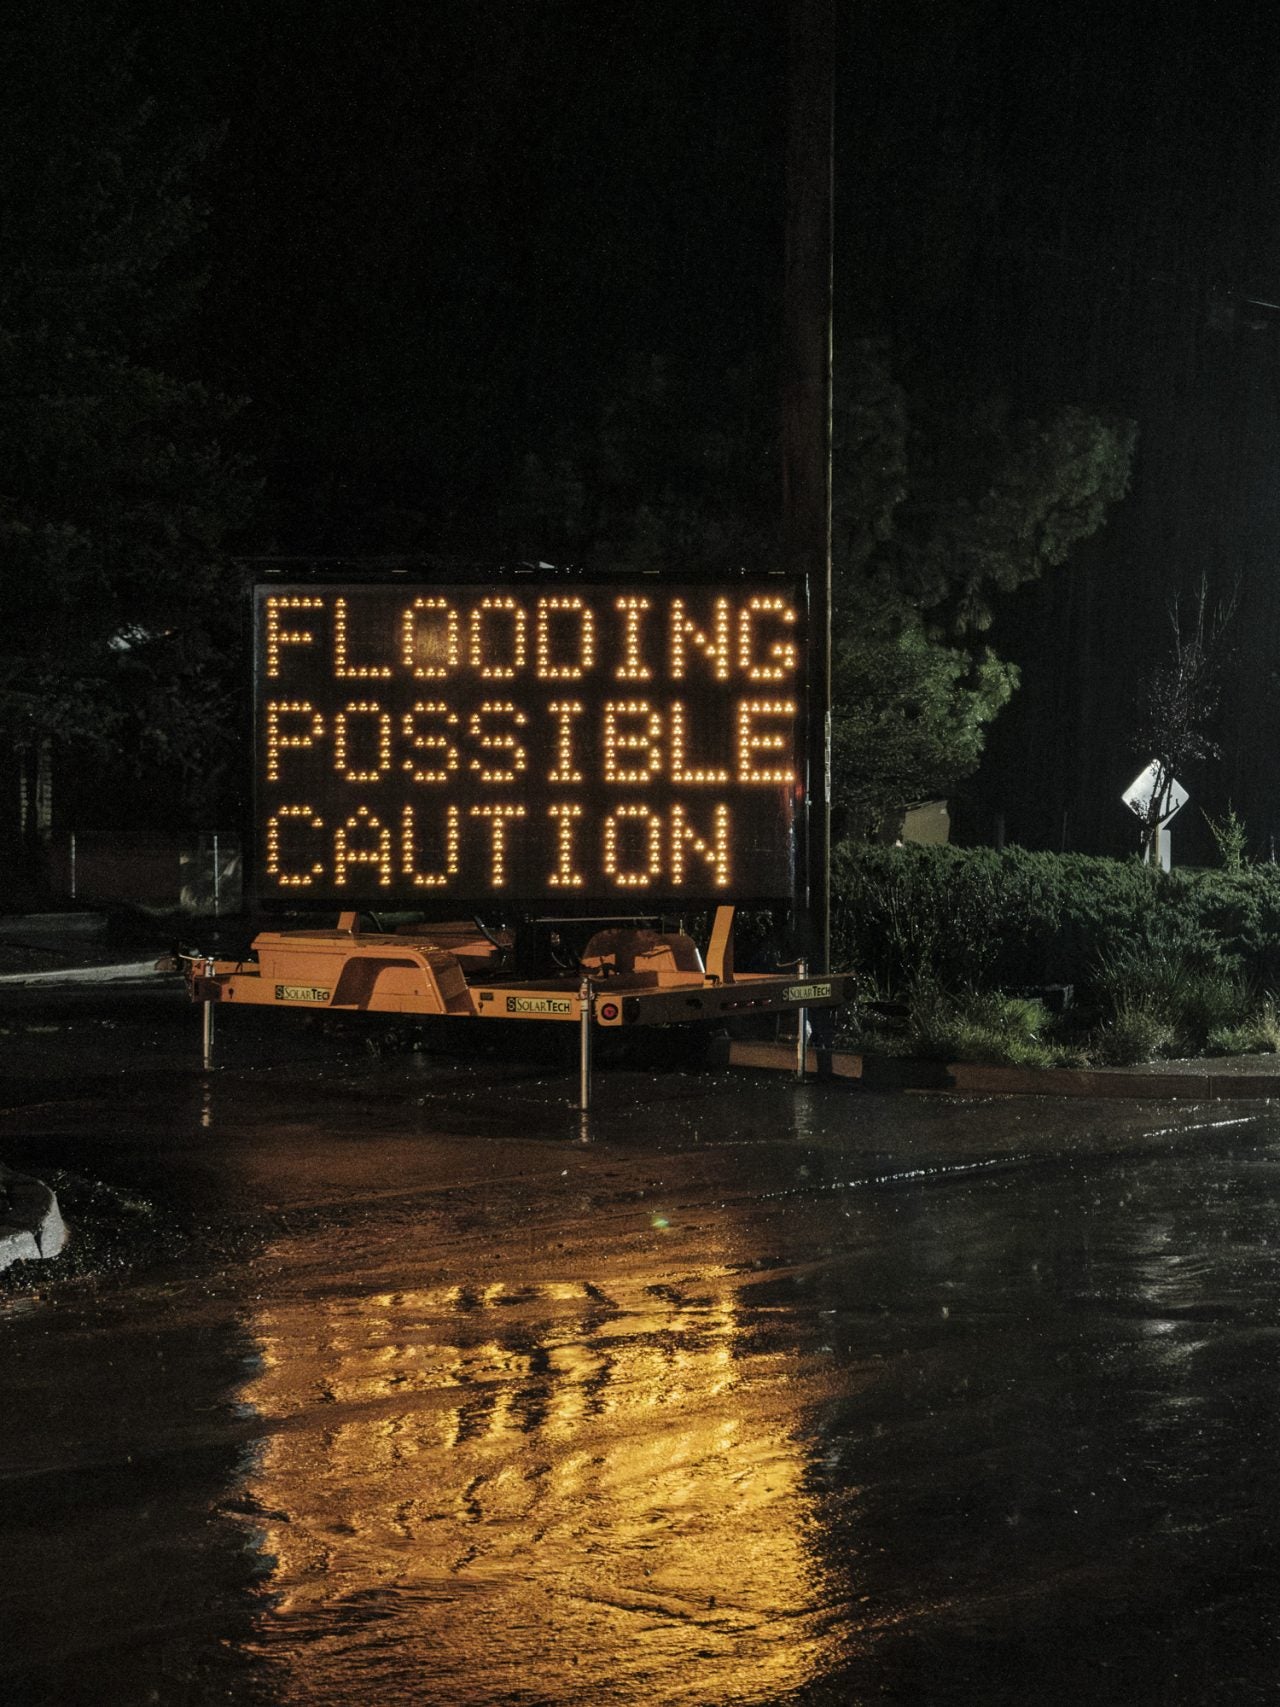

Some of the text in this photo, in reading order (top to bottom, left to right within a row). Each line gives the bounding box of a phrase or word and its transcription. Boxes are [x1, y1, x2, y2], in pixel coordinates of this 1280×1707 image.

[267, 596, 795, 679] FLOODING
[267, 701, 795, 783] POSSIBLE
[267, 804, 727, 886] CAUTION
